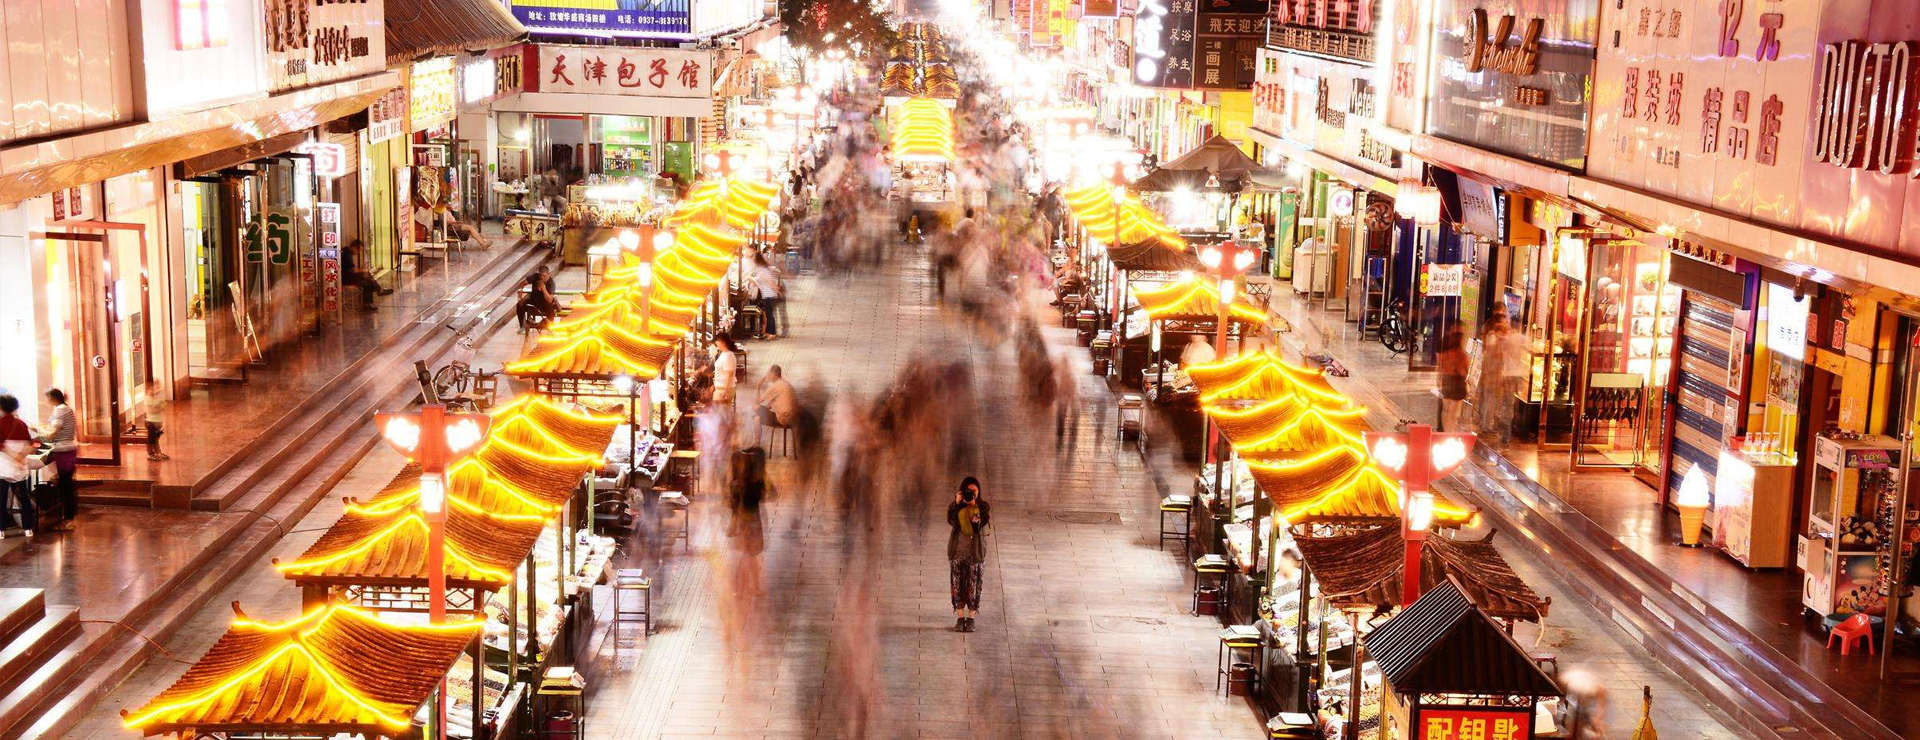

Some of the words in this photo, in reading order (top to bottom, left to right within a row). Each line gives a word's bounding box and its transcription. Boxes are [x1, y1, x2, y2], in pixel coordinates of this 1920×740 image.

[1169, 28, 1192, 42] 足浴
[550, 54, 701, 90] 天津包子馆
[1168, 56, 1191, 71] 养生
[1204, 51, 1220, 85] 画展
[1622, 67, 1684, 126] 服装城
[1702, 86, 1783, 167] 精品店
[247, 212, 290, 264] 药
[322, 209, 336, 246] 打印
[1427, 716, 1519, 740] 配钥匙
